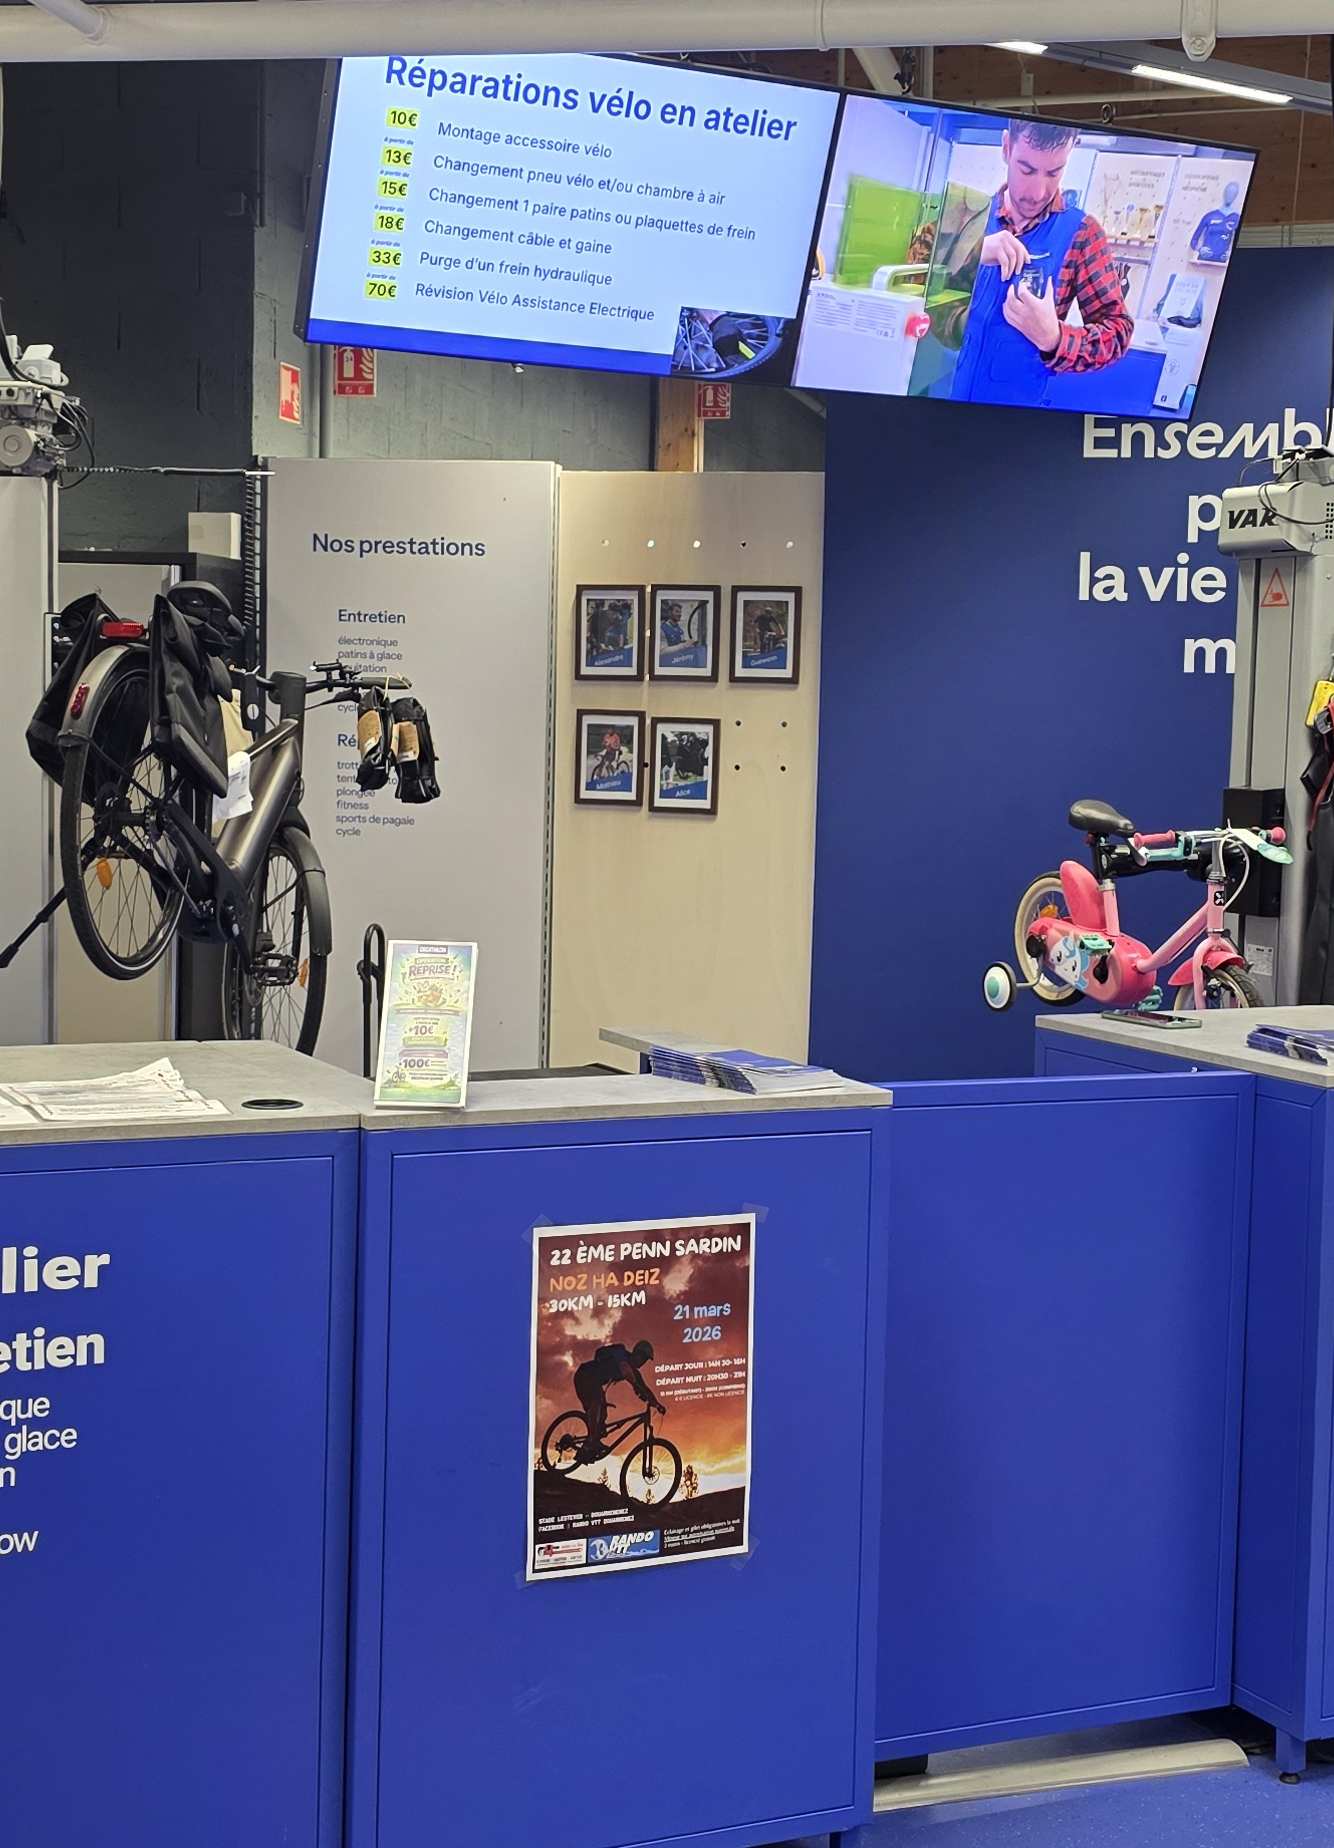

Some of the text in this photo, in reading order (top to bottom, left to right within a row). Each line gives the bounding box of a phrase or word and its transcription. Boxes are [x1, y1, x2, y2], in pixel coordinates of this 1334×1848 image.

[385, 56, 797, 140] Réparations vélo en atelier
[390, 111, 417, 127] 10€
[438, 122, 612, 158] Montage accessoire vélo
[385, 149, 412, 165] 13€
[381, 180, 407, 197] 15€
[434, 155, 725, 205] Changement pneu vélo et/ou chambre à air
[378, 215, 404, 231] 18€
[429, 188, 756, 240] Changement 1 paire patins ou plaquettes de frein
[424, 220, 612, 254] Changement câble et gaine
[372, 250, 401, 265] 33€
[420, 251, 461, 270] Purge
[499, 261, 529, 276] frein
[534, 264, 612, 286] hydraulique
[367, 282, 397, 298] 70€
[416, 283, 655, 321] Révision Vélo Assistance Electrique
[1228, 507, 1278, 529] VAR
[313, 533, 486, 557] Nos prestations
[1079, 551, 1226, 603] la vie
[338, 610, 406, 624] Entretien
[338, 636, 398, 647] électronique
[338, 650, 403, 662] patins à glace
[337, 801, 369, 810] fitness
[336, 815, 414, 826] sports de pagaie
[336, 828, 361, 837] cycle
[550, 1235, 742, 1266] 22 ÈME PENN SARDIN
[550, 1268, 661, 1293] NOZ HA DEIZ
[549, 1290, 646, 1313] 30KM 15KM
[674, 1303, 731, 1320] 21 mars
[683, 1326, 721, 1343] 2026
[4, 1426, 77, 1460] glace
